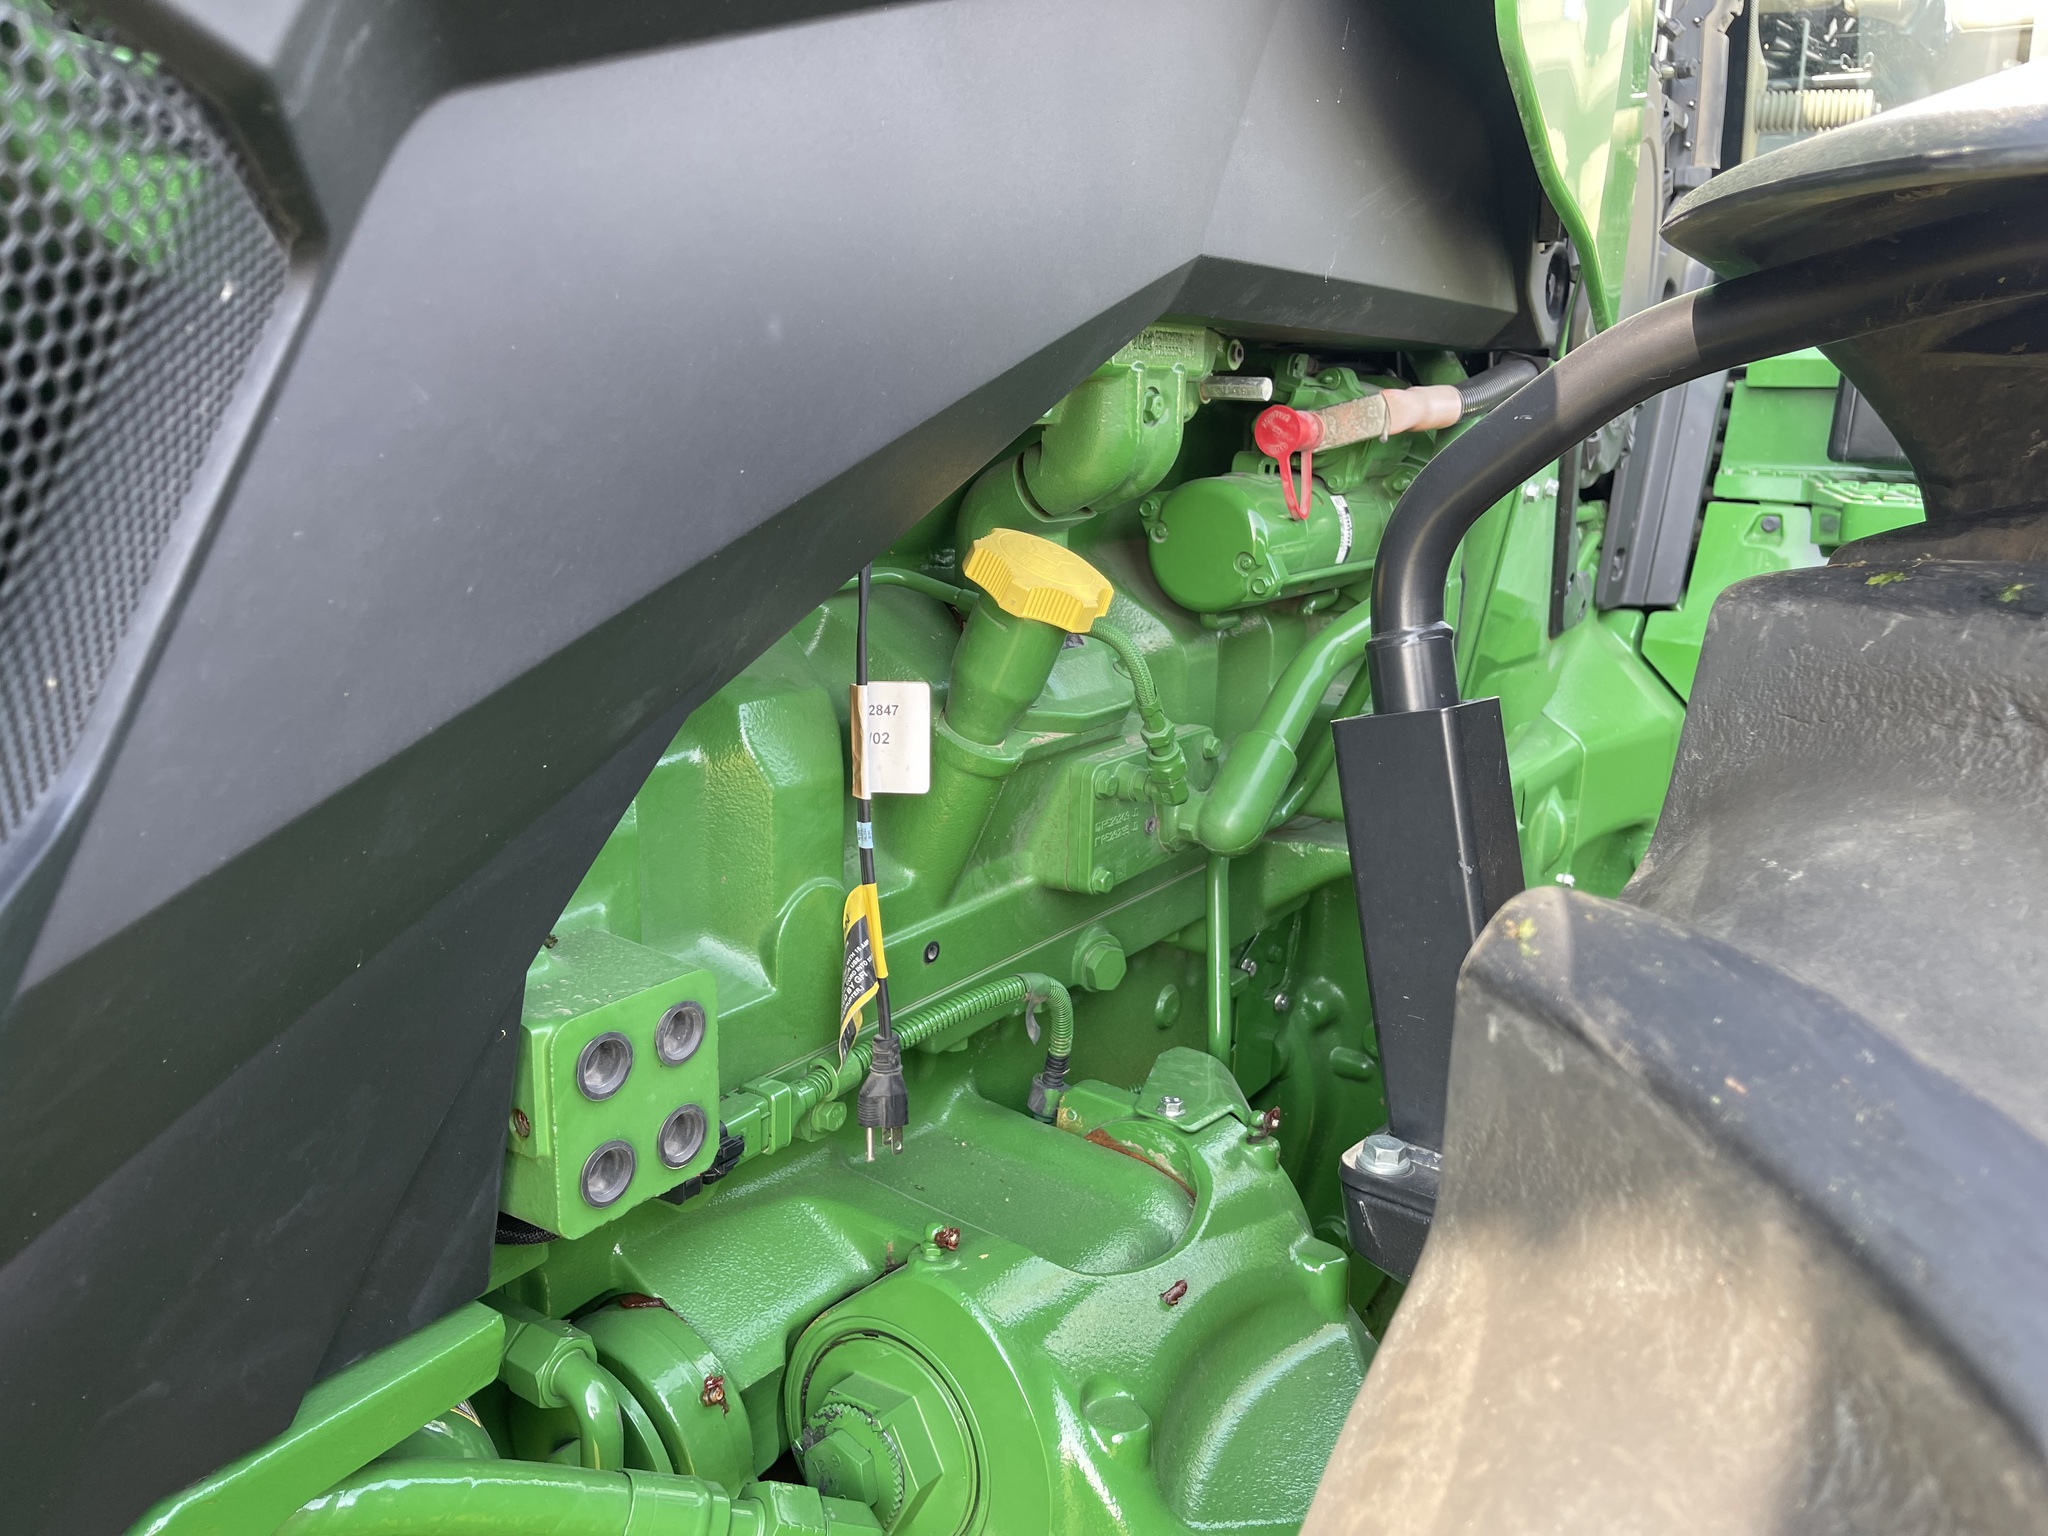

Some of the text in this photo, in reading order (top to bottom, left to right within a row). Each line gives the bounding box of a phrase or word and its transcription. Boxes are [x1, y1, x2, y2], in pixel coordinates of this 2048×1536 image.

[868, 704, 899, 716] 2847
[855, 960, 869, 973] INTO
[846, 981, 855, 995] BY
[854, 970, 868, 984] GFI
